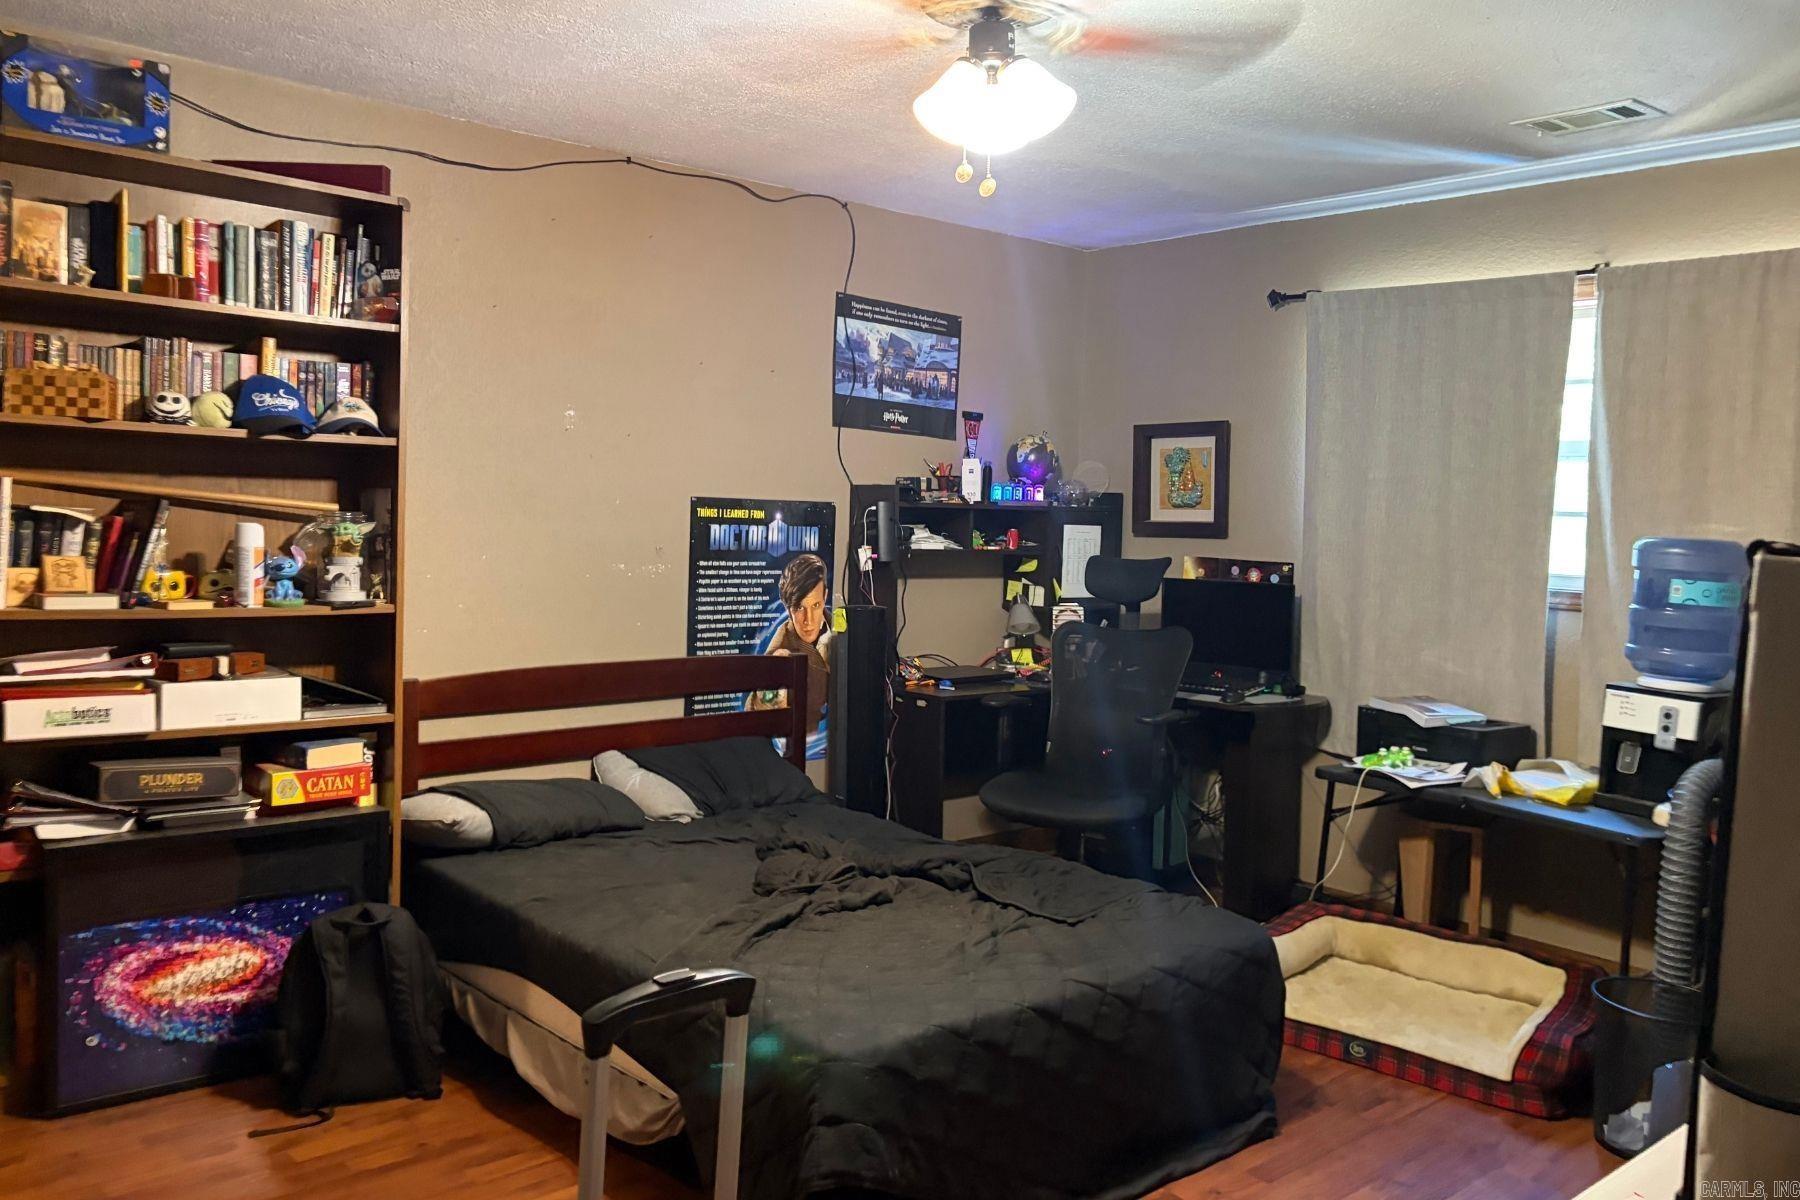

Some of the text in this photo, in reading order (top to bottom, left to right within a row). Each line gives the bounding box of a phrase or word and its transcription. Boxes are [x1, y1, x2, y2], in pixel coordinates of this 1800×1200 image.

[696, 507, 718, 518] THINGS
[723, 508, 749, 519] LEARNED
[750, 509, 765, 519] FROM
[709, 523, 767, 551] DOCTOR
[788, 525, 819, 552] WHO
[139, 772, 204, 787] PLUNDER
[306, 774, 355, 793] CATAN
